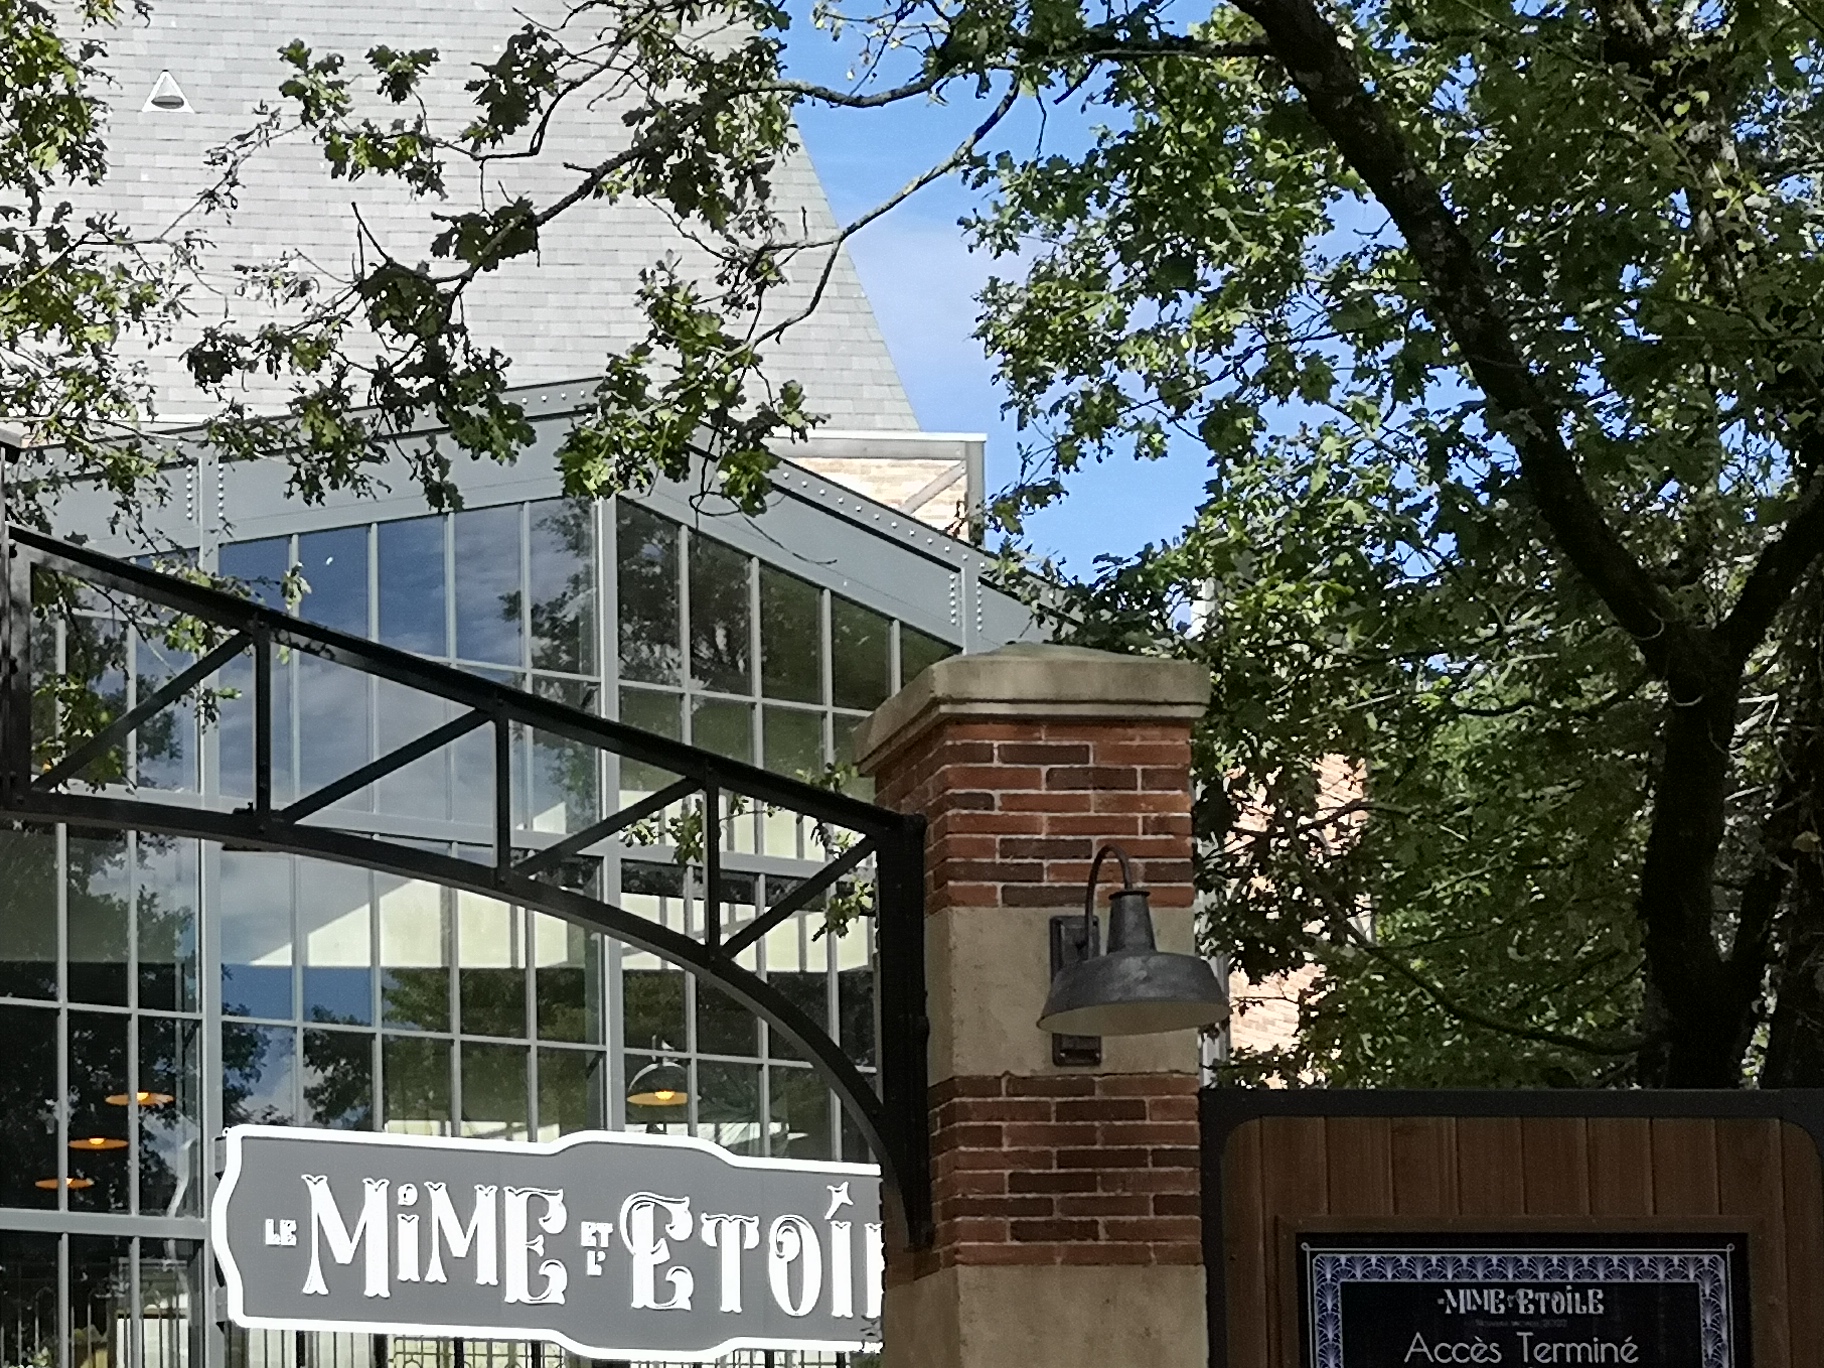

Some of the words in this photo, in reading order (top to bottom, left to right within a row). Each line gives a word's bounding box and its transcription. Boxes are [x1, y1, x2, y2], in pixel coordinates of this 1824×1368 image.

[264, 1218, 297, 1246] LE
[580, 1220, 614, 1248] ET
[1403, 1331, 1502, 1364] Accès
[1516, 1331, 1639, 1364] Terminé
